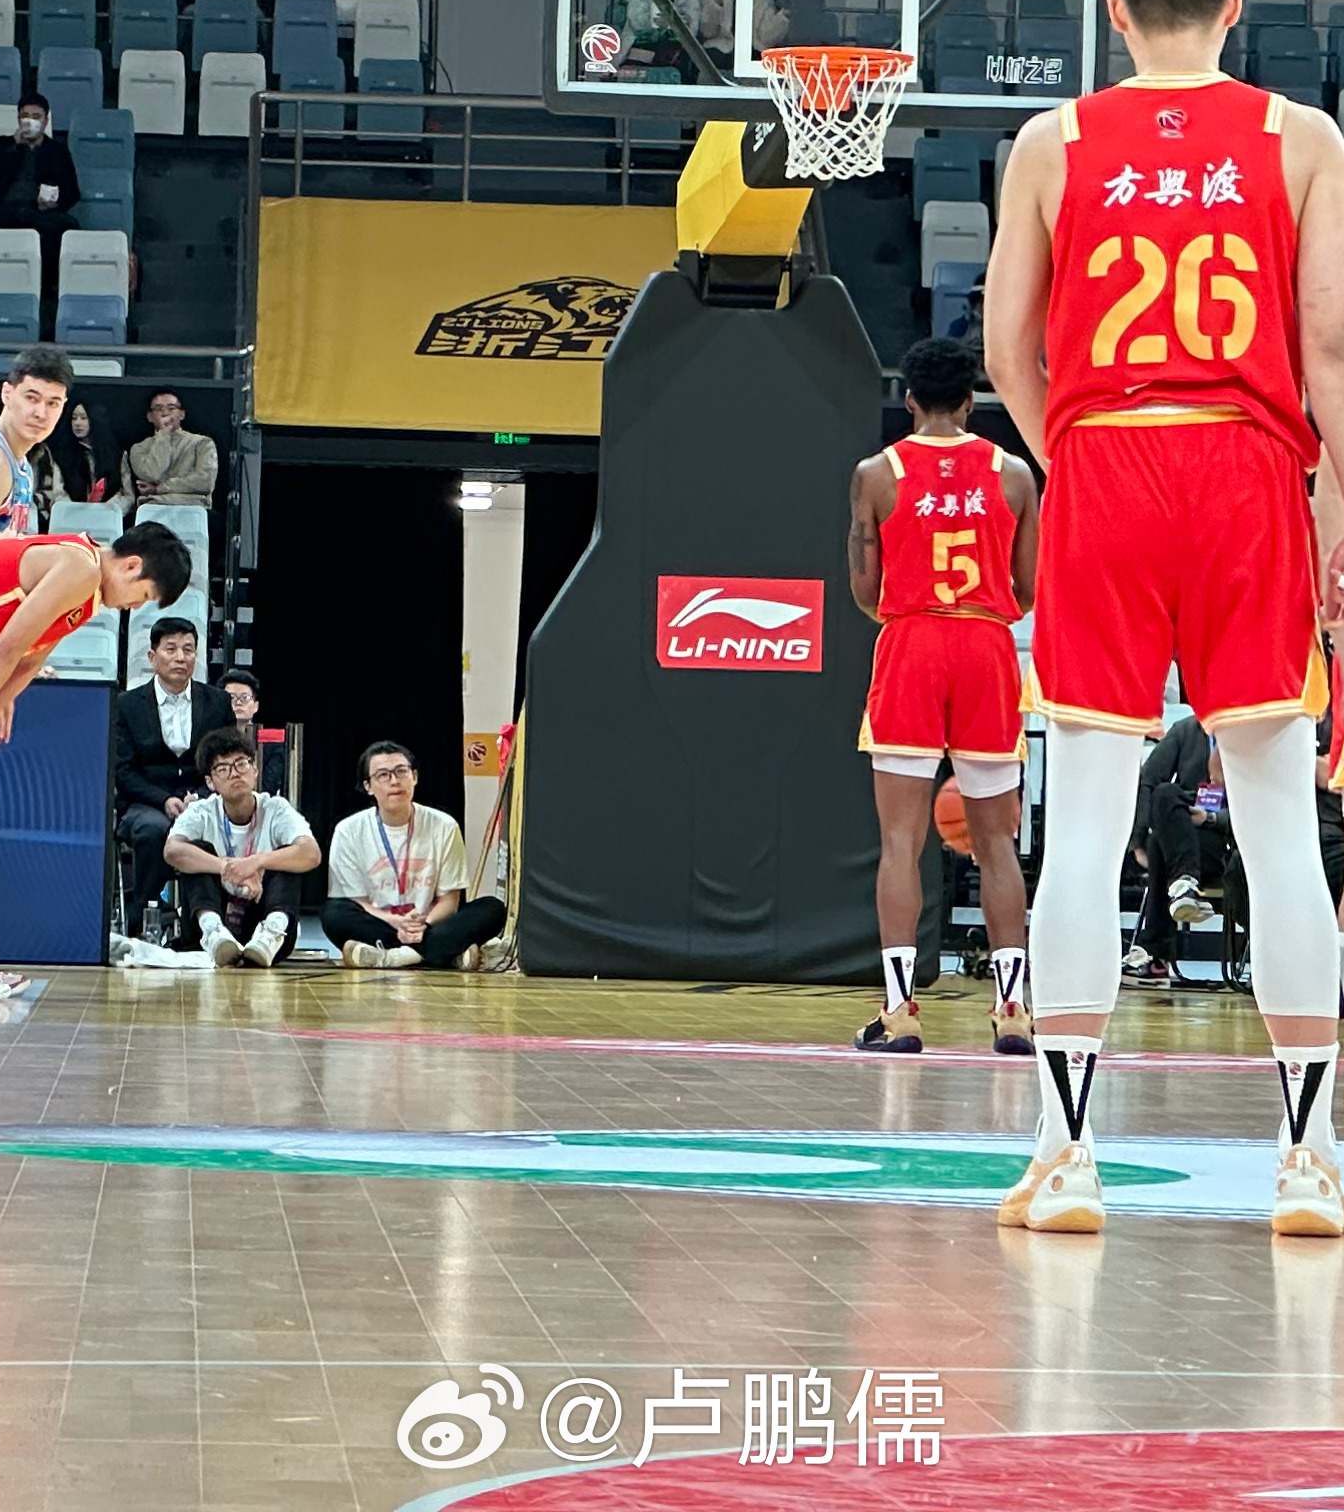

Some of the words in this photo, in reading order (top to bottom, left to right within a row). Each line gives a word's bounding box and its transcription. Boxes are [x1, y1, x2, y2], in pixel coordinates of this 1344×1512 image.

[1087, 233, 1259, 368] 26
[932, 529, 981, 604] 5
[667, 636, 811, 661] LI-NING
